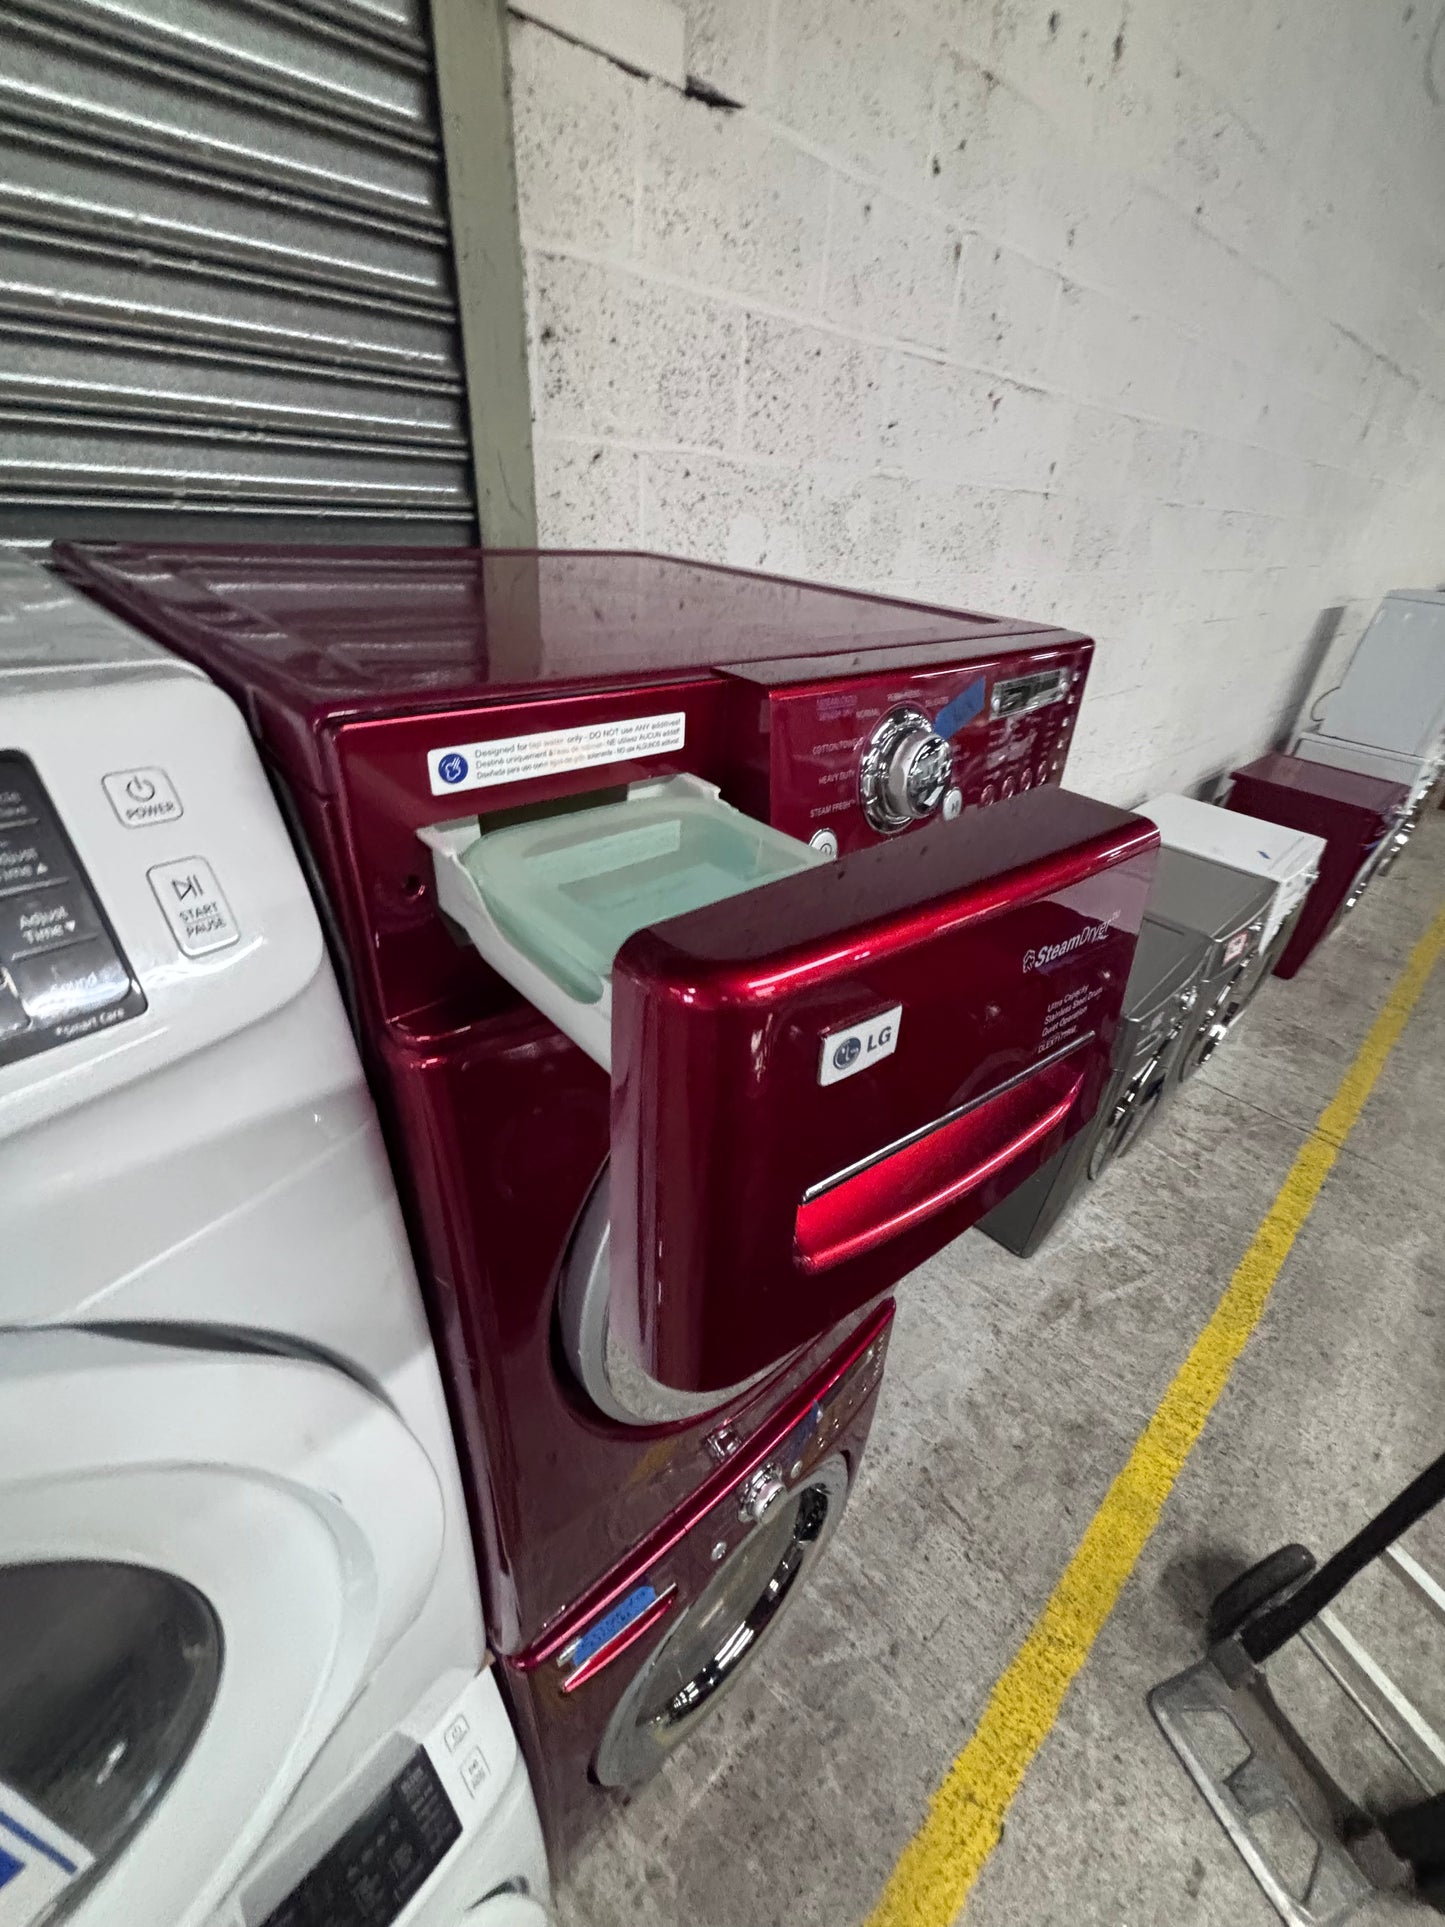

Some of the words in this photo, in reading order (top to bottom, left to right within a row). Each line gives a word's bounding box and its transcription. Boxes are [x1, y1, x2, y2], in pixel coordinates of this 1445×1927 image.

[475, 744, 515, 758] Designed
[517, 743, 527, 751] for
[567, 734, 583, 743] only
[589, 731, 601, 740] DO
[603, 728, 619, 737] NOT
[621, 727, 633, 735] use
[635, 723, 650, 732] ANY
[505, 751, 547, 764] uniquement
[126, 801, 175, 820] POWER
[810, 804, 832, 818] STEAM
[179, 901, 218, 922] START
[186, 917, 226, 938] PAUSE
[1047, 1000, 1063, 1012] Ultra
[1064, 984, 1089, 1003] Capacity
[867, 1026, 892, 1053] LG
